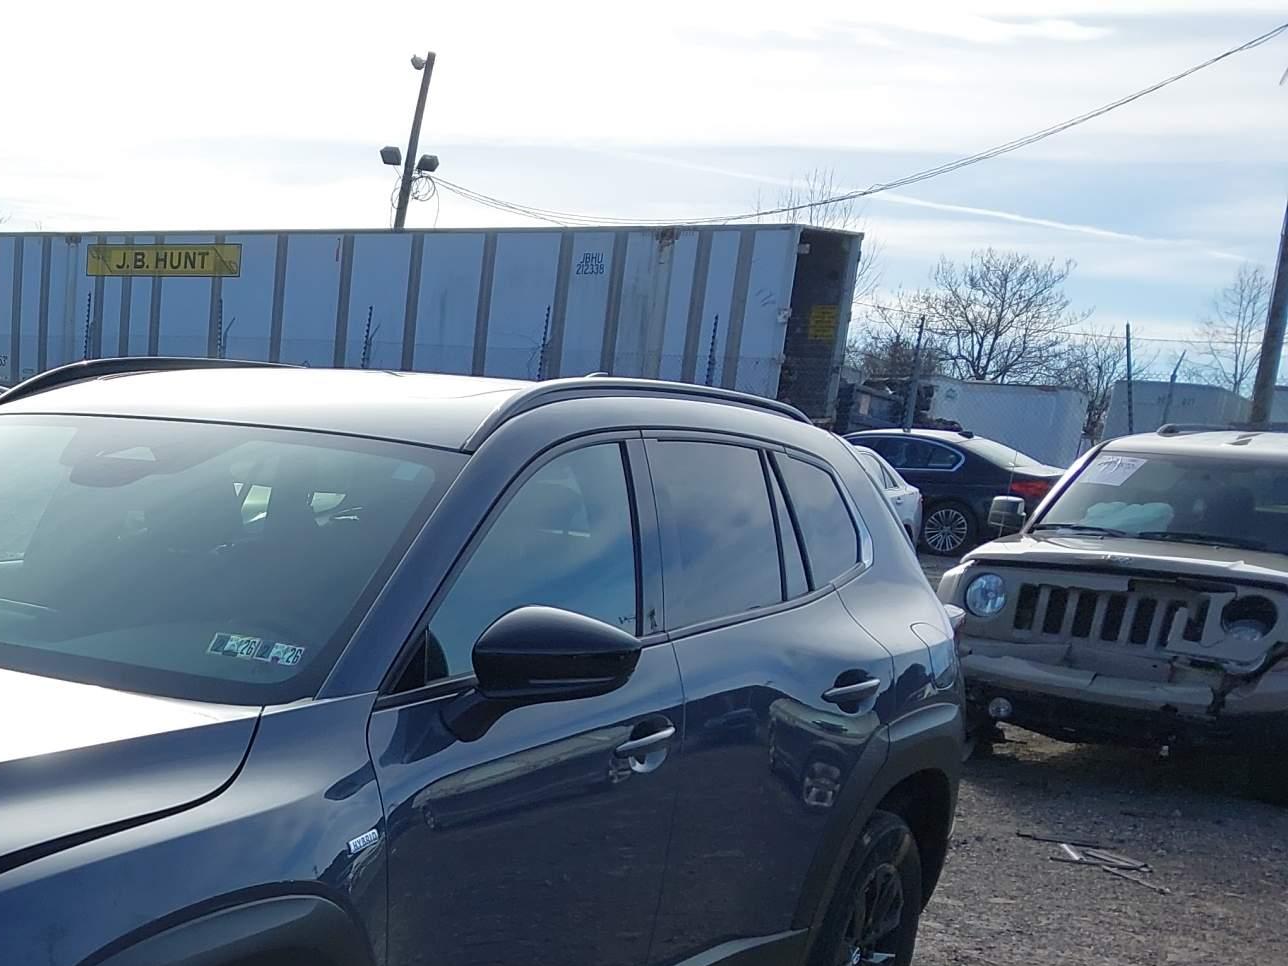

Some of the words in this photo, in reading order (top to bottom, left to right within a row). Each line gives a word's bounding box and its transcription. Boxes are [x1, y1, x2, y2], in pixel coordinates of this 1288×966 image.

[154, 252, 210, 270] HUNT
[580, 253, 604, 264] JBHU
[576, 263, 605, 275] 212338
[285, 647, 303, 664] 26
